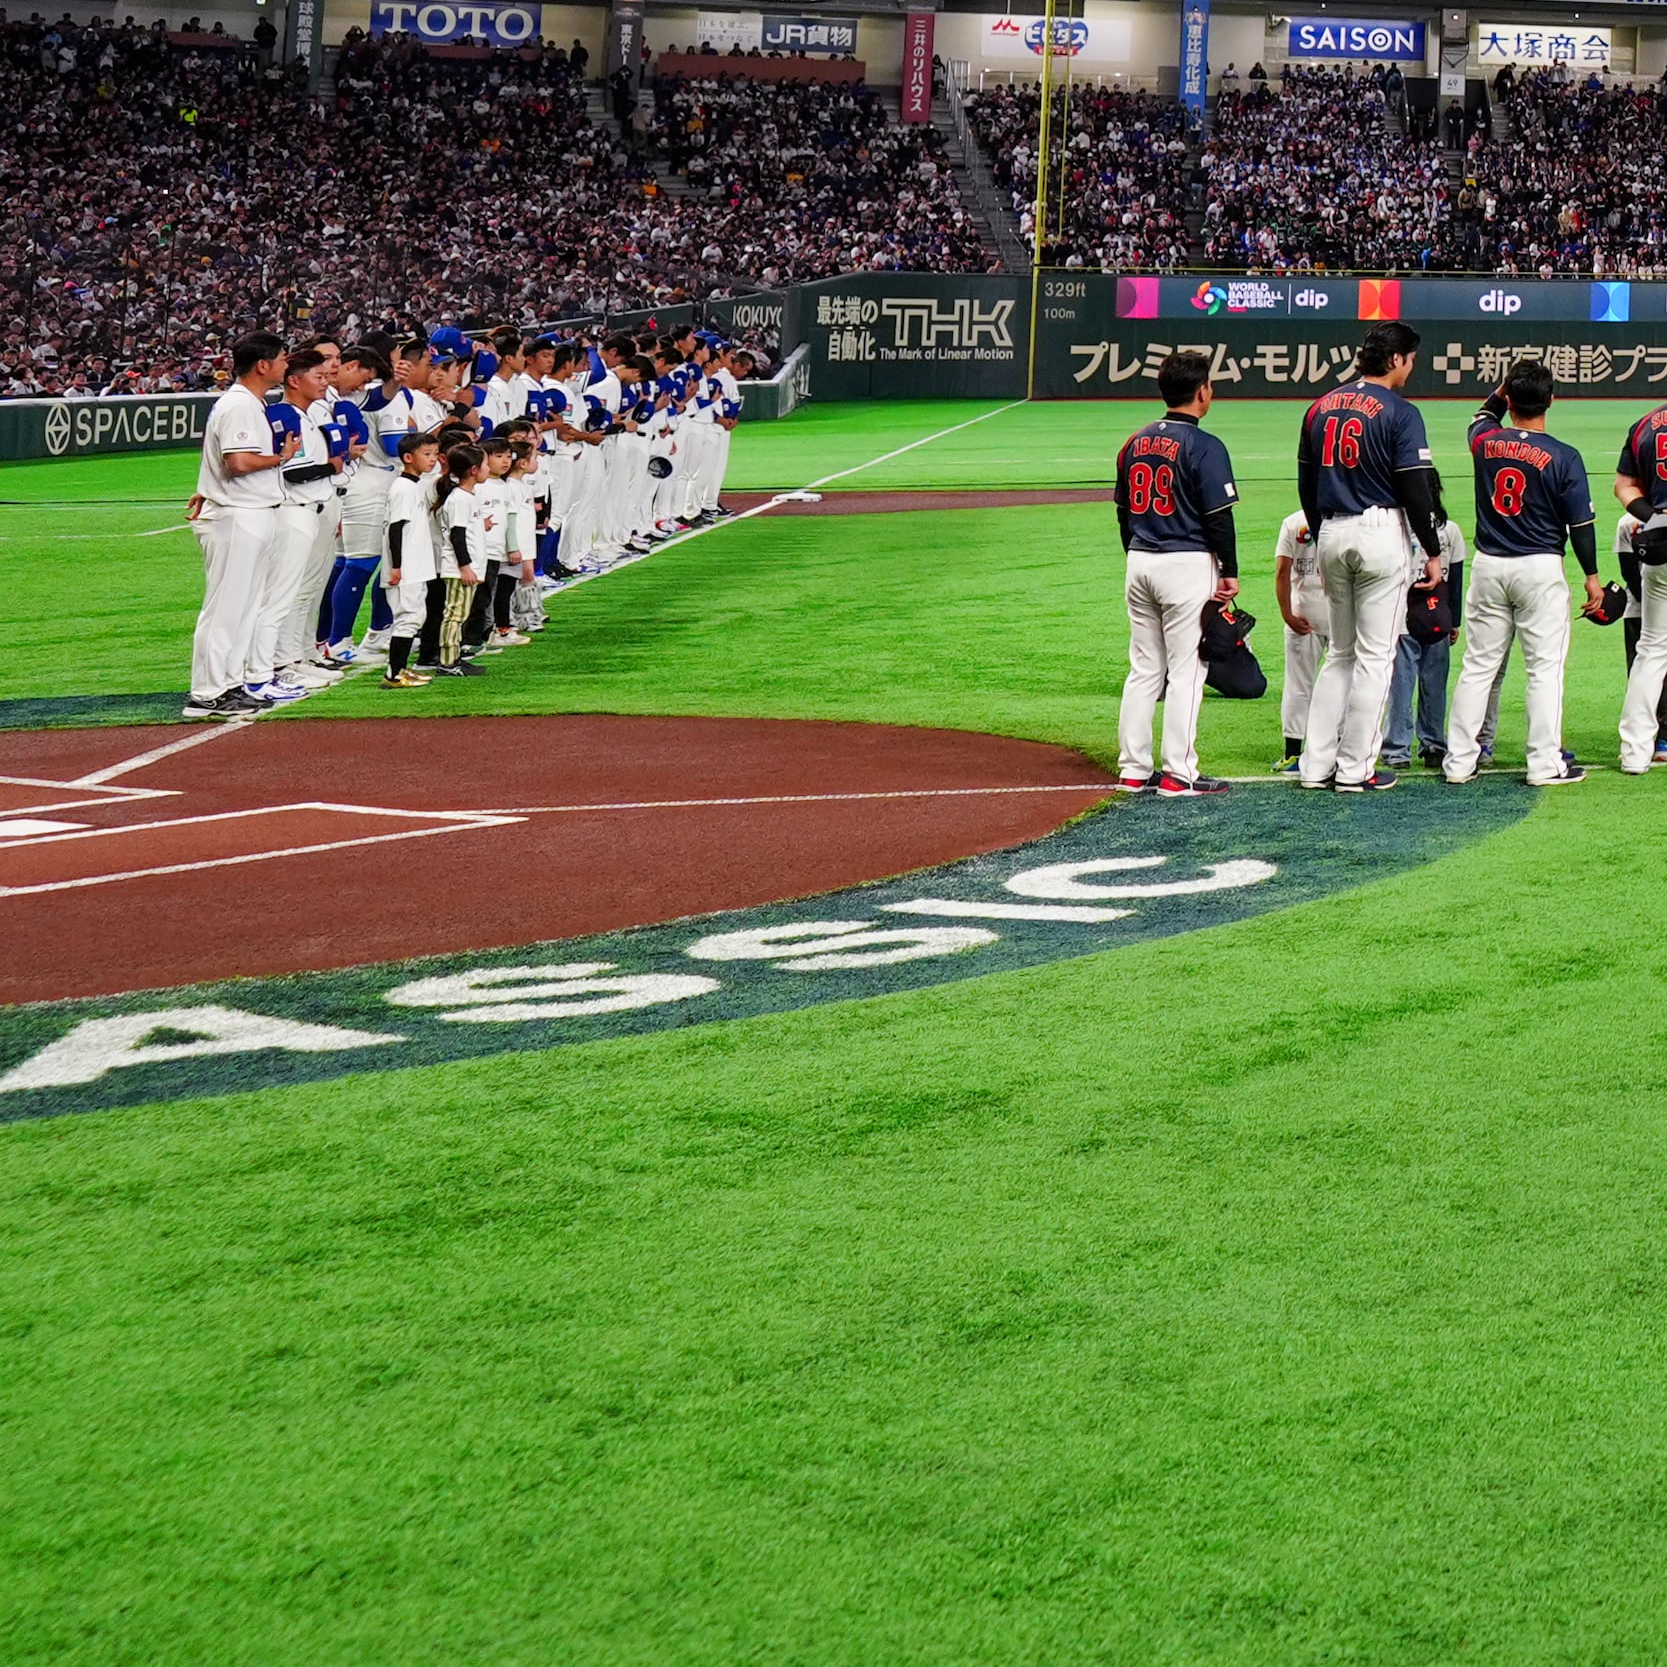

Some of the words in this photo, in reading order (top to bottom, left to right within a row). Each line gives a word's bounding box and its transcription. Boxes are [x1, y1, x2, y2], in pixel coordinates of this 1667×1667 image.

[378, 2, 534, 40] TOTO
[766, 22, 853, 47] JR貨物
[1299, 24, 1416, 53] SAISON
[1479, 31, 1611, 61] 大塚商会
[913, 19, 926, 113] 三井のリハウス
[1446, 78, 1458, 88] 49
[1044, 281, 1087, 298] 329ft
[1228, 282, 1270, 291] WORLD
[1228, 290, 1284, 300] BASEBALL
[1294, 289, 1329, 310] dip
[816, 295, 879, 325] 最先端の
[1043, 307, 1076, 320] 100m
[1228, 299, 1275, 308] CLASSIC
[1478, 289, 1522, 316] dip
[881, 298, 1016, 347] THK
[879, 347, 897, 360] The
[898, 348, 922, 360] Mark
[924, 348, 936, 360] of
[938, 347, 972, 360] Linear
[974, 347, 1014, 360] Motion
[1319, 391, 1385, 420] OHTANI
[1133, 436, 1181, 463] IBATA
[1321, 416, 1363, 469] 16
[1484, 439, 1554, 472] KONDOH
[1128, 462, 1176, 516] 89
[1491, 466, 1527, 517] 8
[0, 855, 1278, 1094] ASSIC
